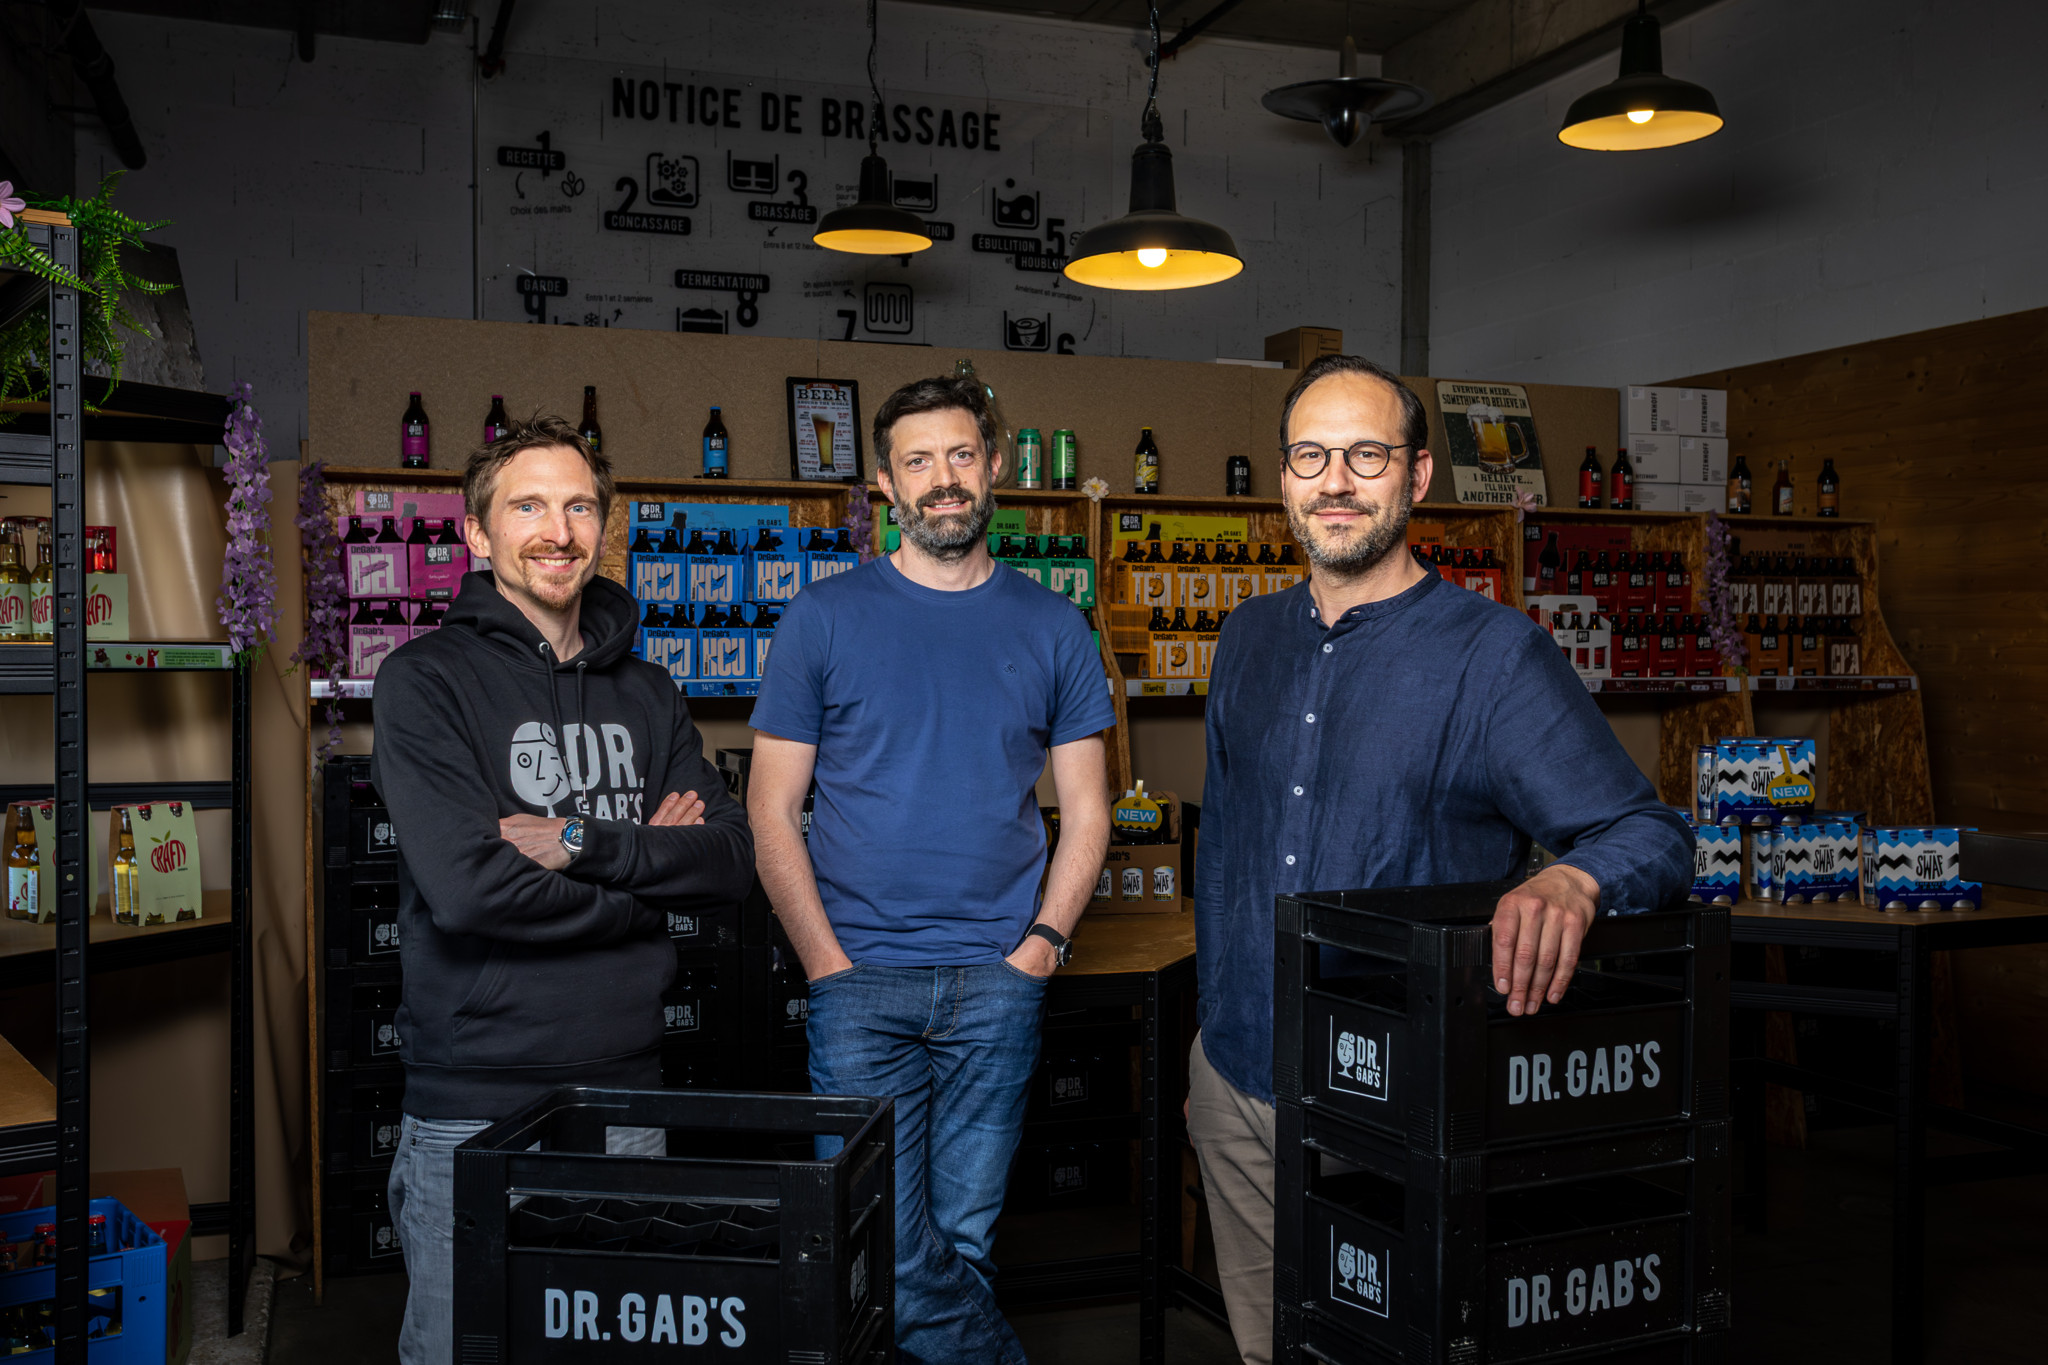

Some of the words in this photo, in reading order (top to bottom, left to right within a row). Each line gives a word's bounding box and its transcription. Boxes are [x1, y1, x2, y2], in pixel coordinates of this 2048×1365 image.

[611, 77, 741, 129] NOTICE
[761, 92, 802, 134] DE
[822, 98, 1001, 151] BRASSAGE
[506, 150, 557, 167] RECETTE
[615, 177, 638, 214] 2
[787, 170, 807, 207] 3
[510, 205, 531, 215] Choix
[534, 205, 548, 214] des
[755, 205, 812, 222] BRASSAGE
[611, 214, 685, 232] CONCASSAGE
[978, 234, 1036, 253] ÉBULLITION
[1047, 219, 1064, 257] 5
[524, 278, 561, 293] GARDE
[682, 272, 764, 291] FERMENTATION
[737, 287, 758, 327] 8
[837, 309, 857, 340] 7
[797, 388, 847, 402] BEER
[1452, 385, 1488, 395] EVERYONE
[1481, 397, 1491, 406] TO
[1492, 398, 1518, 408] BELIEVE
[1519, 399, 1528, 409] IN
[1650, 392, 1658, 432] RITZENHOFF
[1066, 447, 1075, 474] PÉPITE
[1702, 443, 1710, 482] RITZENHOFF
[1462, 491, 1513, 503] ANOTHER
[1498, 484, 1517, 492] HAVE
[351, 554, 401, 596] DEL
[1144, 685, 1165, 693] TEMPÊTE
[563, 723, 644, 791] DR.
[1773, 785, 1808, 798] NEW
[1118, 809, 1156, 822] NEW
[150, 839, 187, 874] CRAFTY
[1813, 849, 1835, 873] SWAF
[1916, 855, 1943, 880] SWAF
[1123, 875, 1140, 894] SWAF
[676, 1005, 695, 1019] DR.
[1356, 1035, 1381, 1071] DR.
[1356, 1067, 1380, 1089] GAB'S
[1357, 1247, 1381, 1289] DR.
[1357, 1279, 1381, 1305] GAB'S
